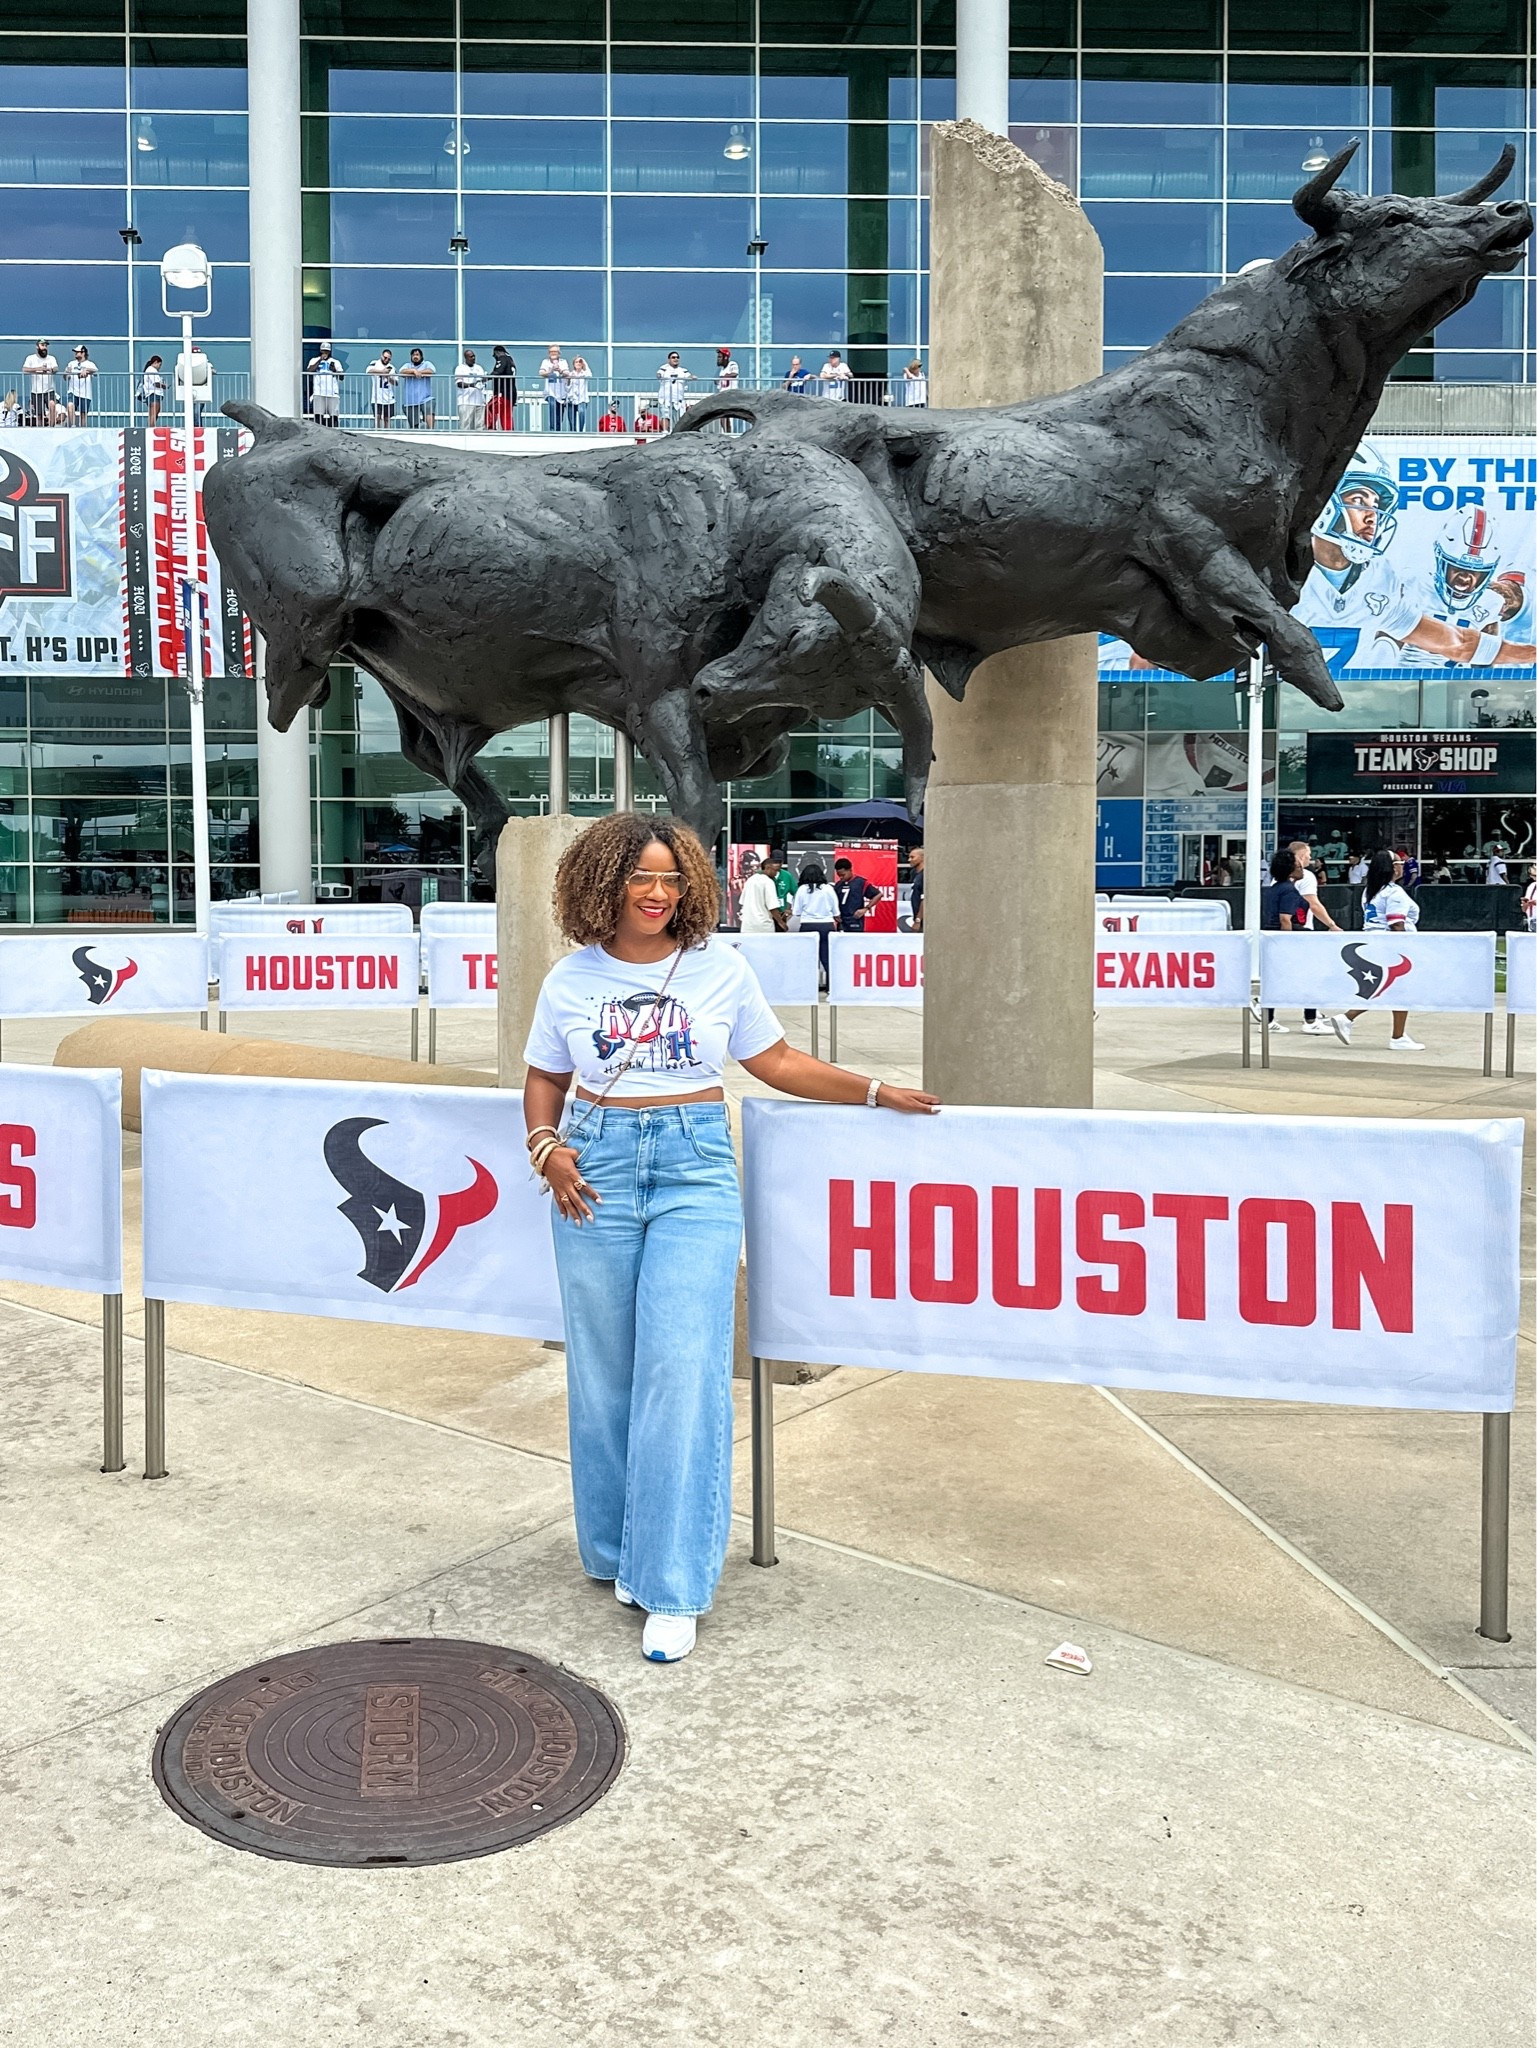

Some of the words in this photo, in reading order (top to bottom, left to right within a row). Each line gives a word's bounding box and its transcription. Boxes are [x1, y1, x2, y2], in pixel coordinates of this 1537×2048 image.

[1399, 458, 1457, 483] BY
[1399, 485, 1486, 511] FOR
[77, 636, 119, 663] UP!
[88, 687, 143, 697] HYUNDAI
[1380, 734, 1428, 743] HOUSTON
[1432, 734, 1472, 743] TEXANS
[1354, 747, 1413, 771] TEAM
[1439, 747, 1498, 771] SHOP
[841, 888, 850, 905] 7
[245, 955, 398, 991] HOUSTON
[829, 1178, 1414, 1334] HOUSTON
[475, 1669, 545, 1699] CITY
[220, 1713, 258, 1736] OF
[528, 1701, 567, 1728] OF
[366, 1693, 414, 1788] STORM
[209, 1741, 304, 1824] HOUSTON
[481, 1728, 572, 1814] HOUSTON
